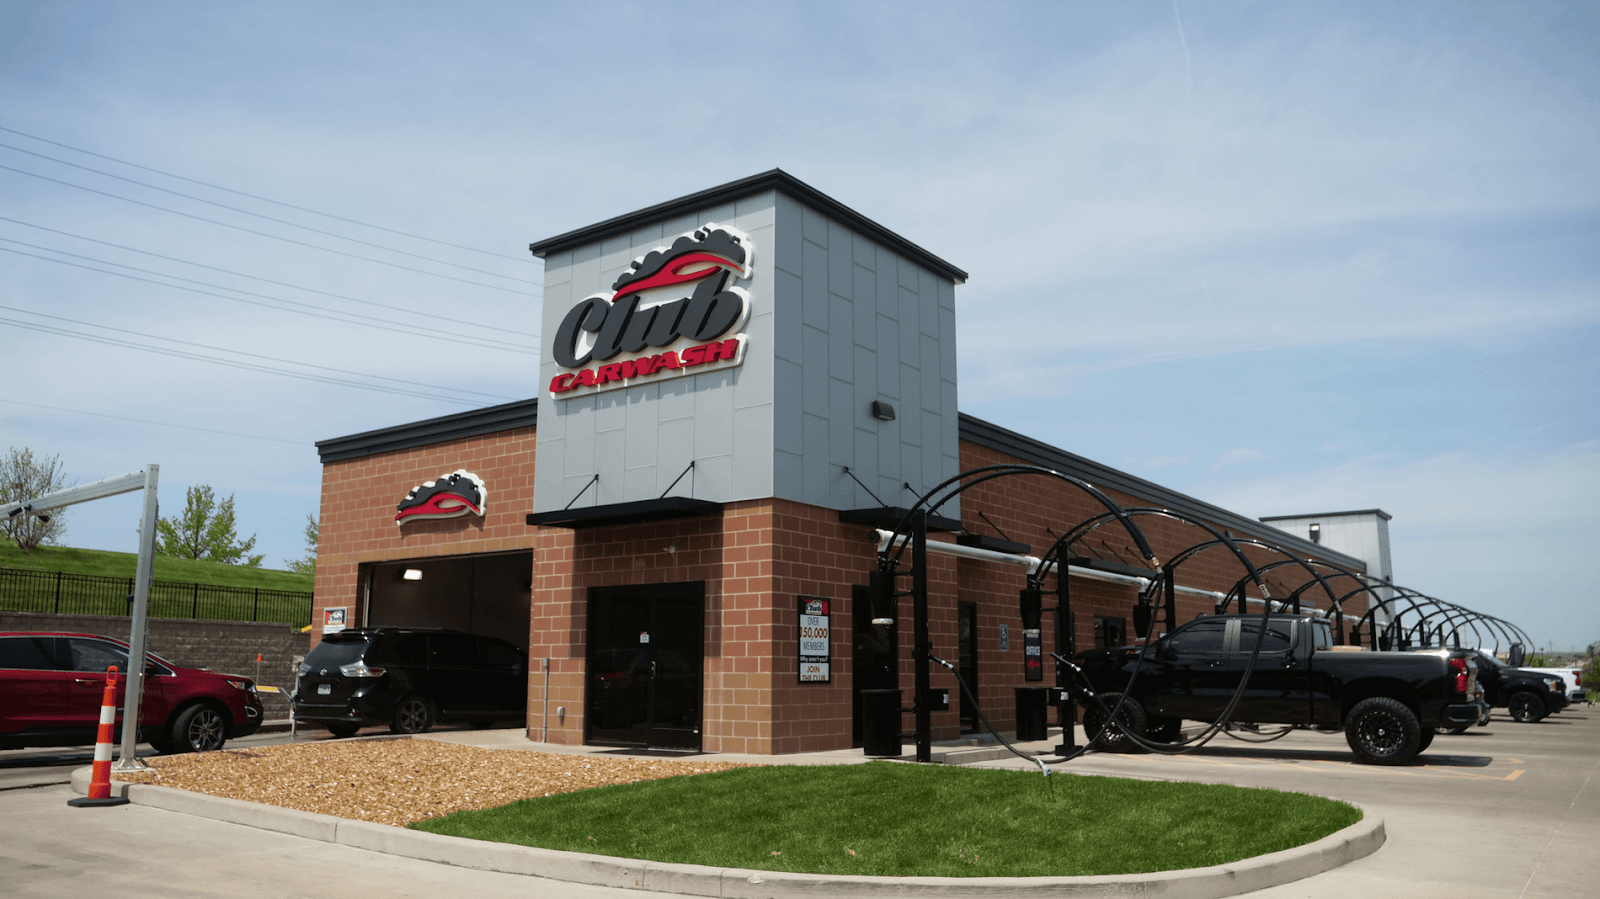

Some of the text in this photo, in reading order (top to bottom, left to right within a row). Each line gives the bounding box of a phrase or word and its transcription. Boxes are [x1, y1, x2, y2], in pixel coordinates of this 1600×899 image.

[553, 269, 744, 369] Club
[549, 338, 740, 393] CARWASH
[807, 616, 819, 626] OVER
[803, 641, 825, 651] MEMBERS
[1026, 645, 1040, 656] OFFICE
[807, 665, 820, 673] JOIN
